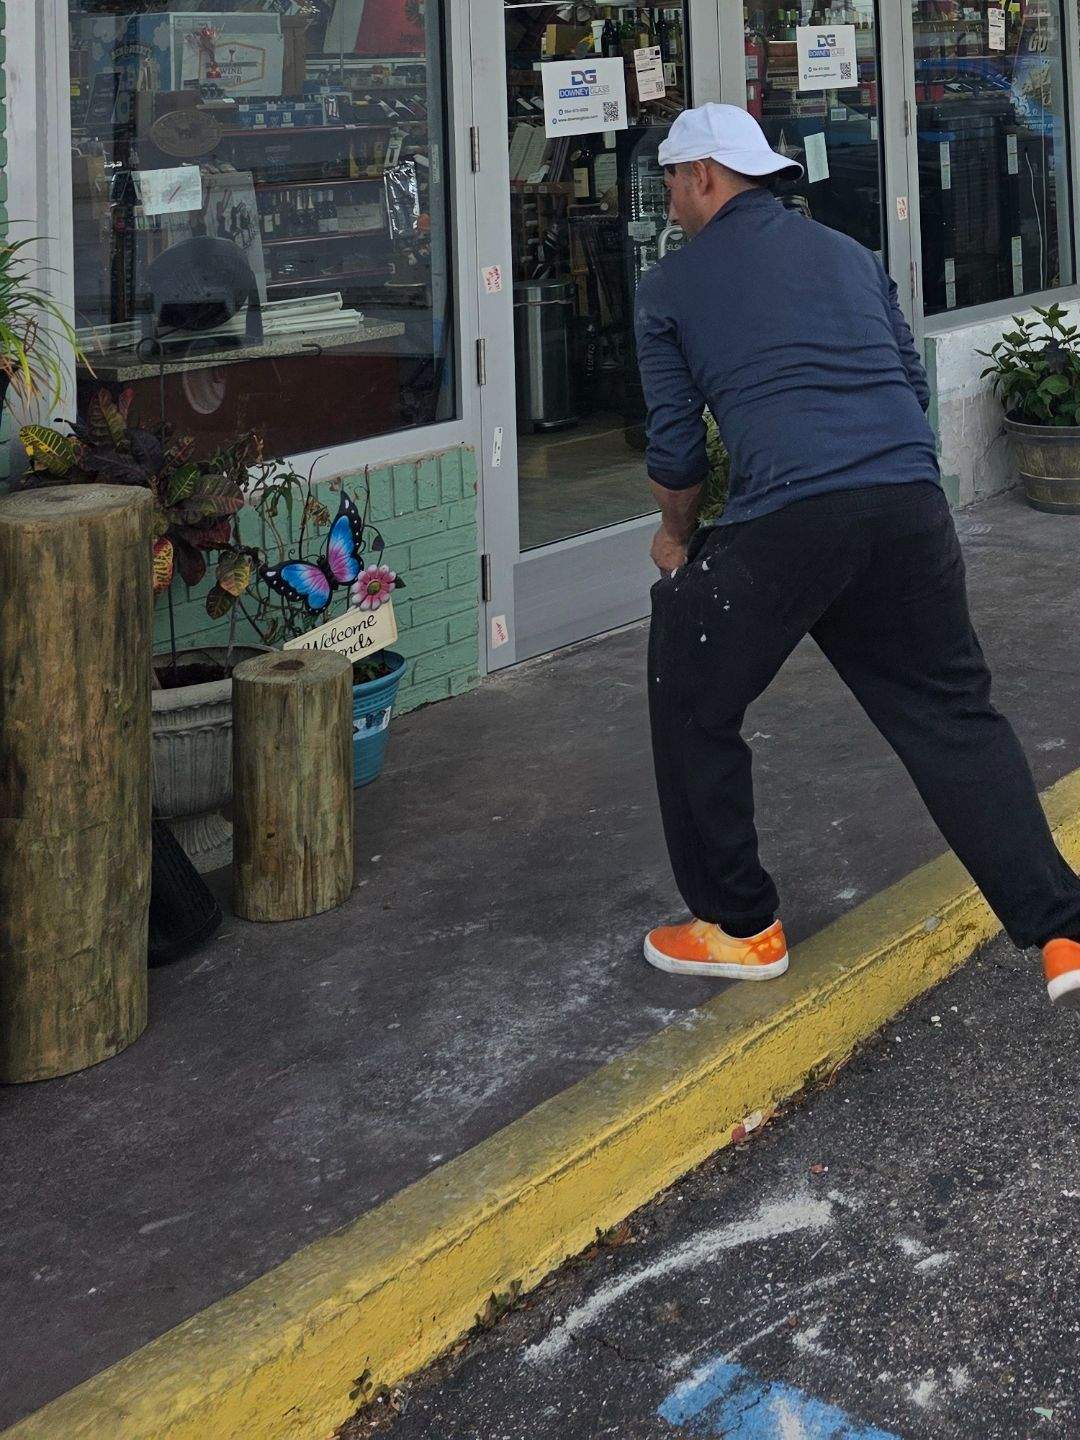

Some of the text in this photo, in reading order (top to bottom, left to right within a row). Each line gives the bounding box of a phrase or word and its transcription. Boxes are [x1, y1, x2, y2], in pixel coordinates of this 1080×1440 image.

[571, 69, 597, 86] DG
[559, 87, 589, 98] DOWNEY
[302, 614, 377, 651] Welcome
